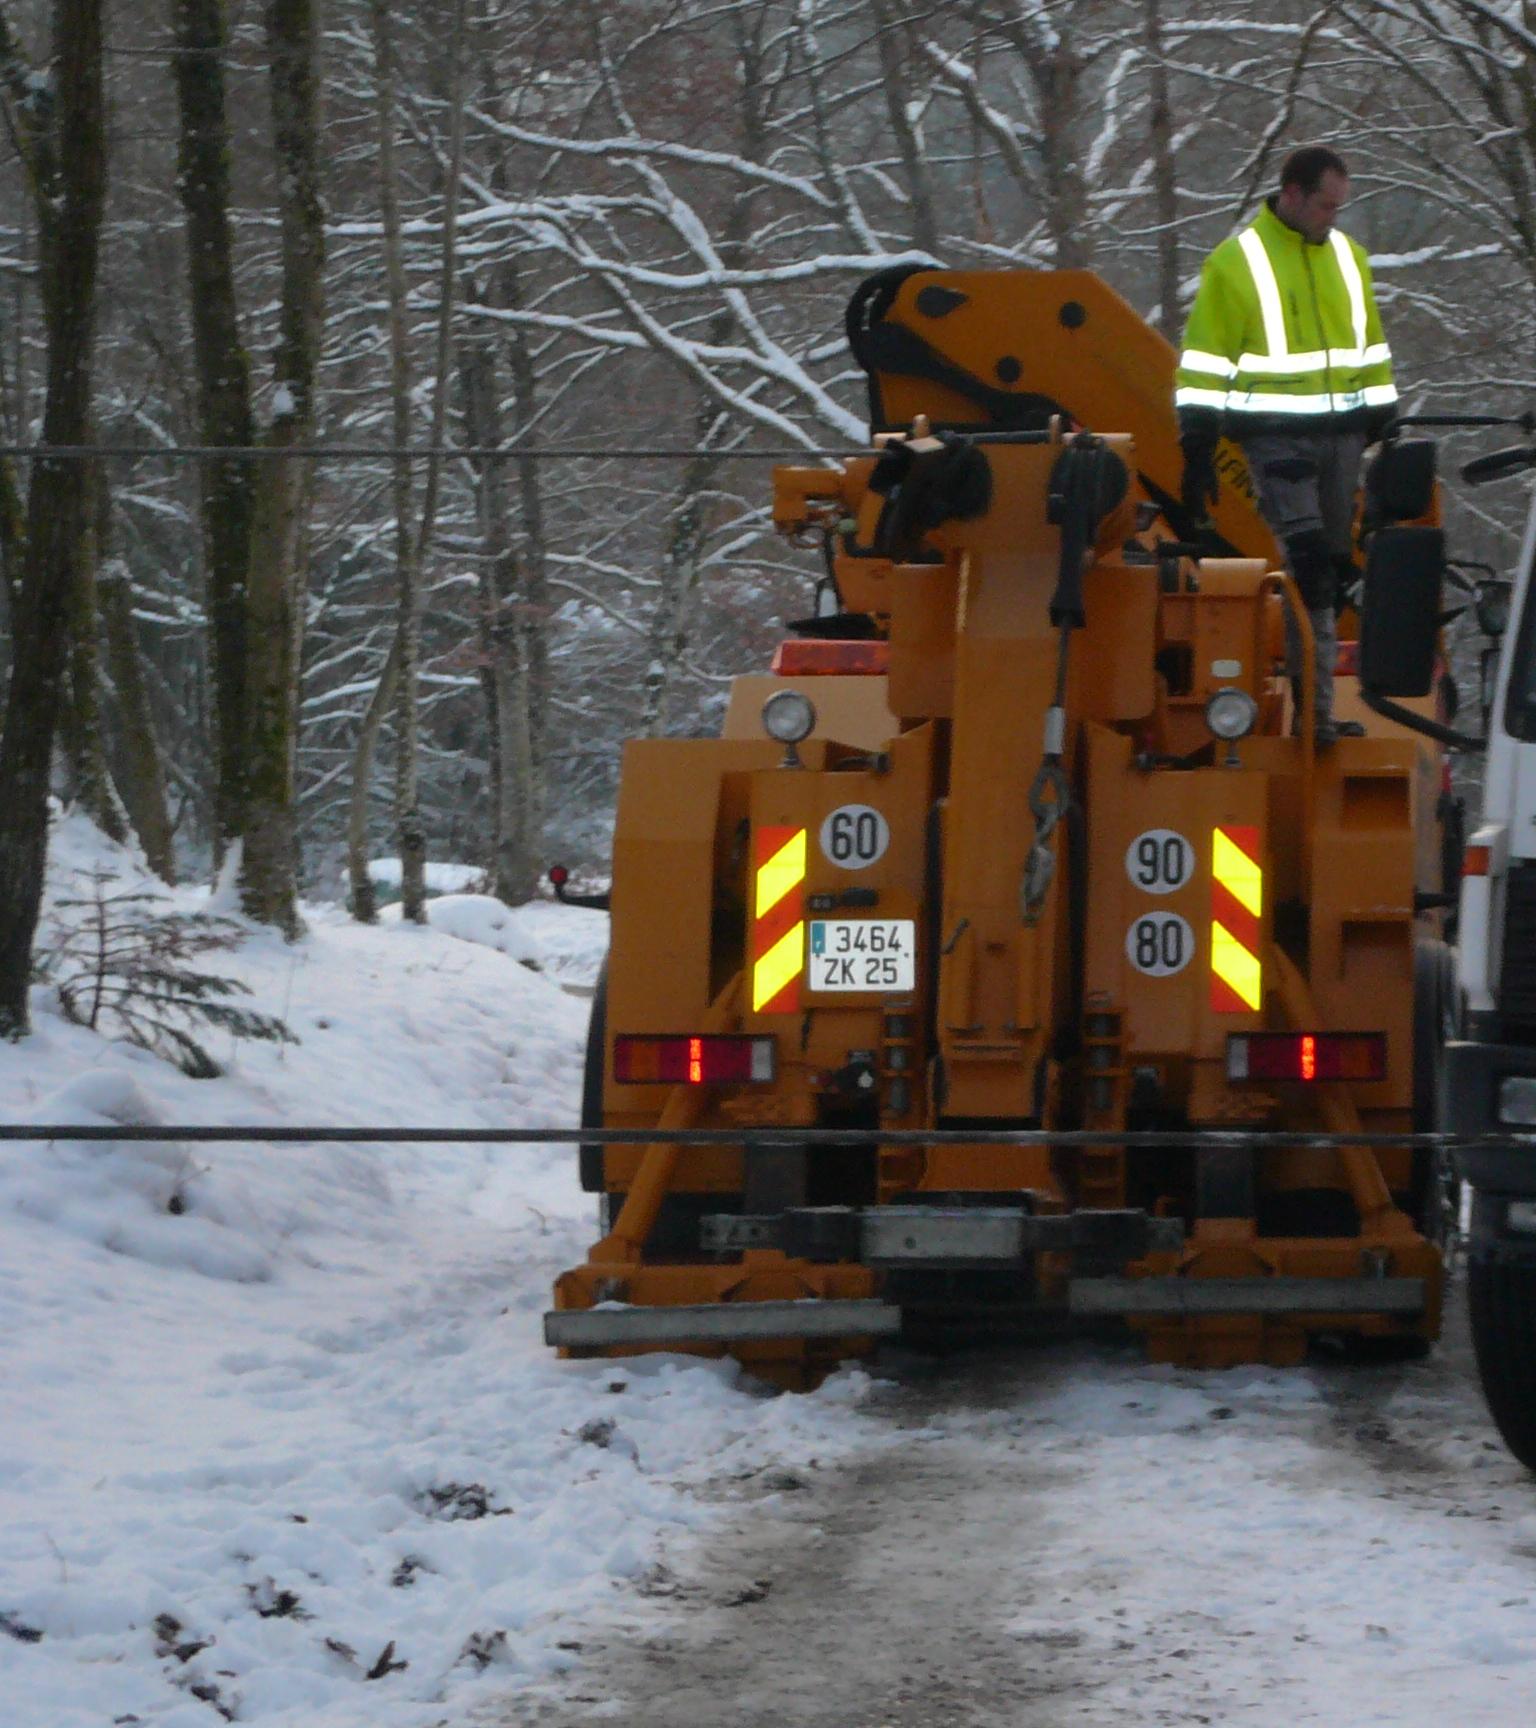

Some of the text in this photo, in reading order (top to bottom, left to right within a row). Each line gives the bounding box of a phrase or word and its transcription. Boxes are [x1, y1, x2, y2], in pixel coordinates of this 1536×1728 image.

[830, 811, 878, 861] 60
[1137, 837, 1184, 885] 90
[835, 925, 902, 953] 3464
[1136, 919, 1182, 968] 80
[823, 958, 898, 986] ZK 25
